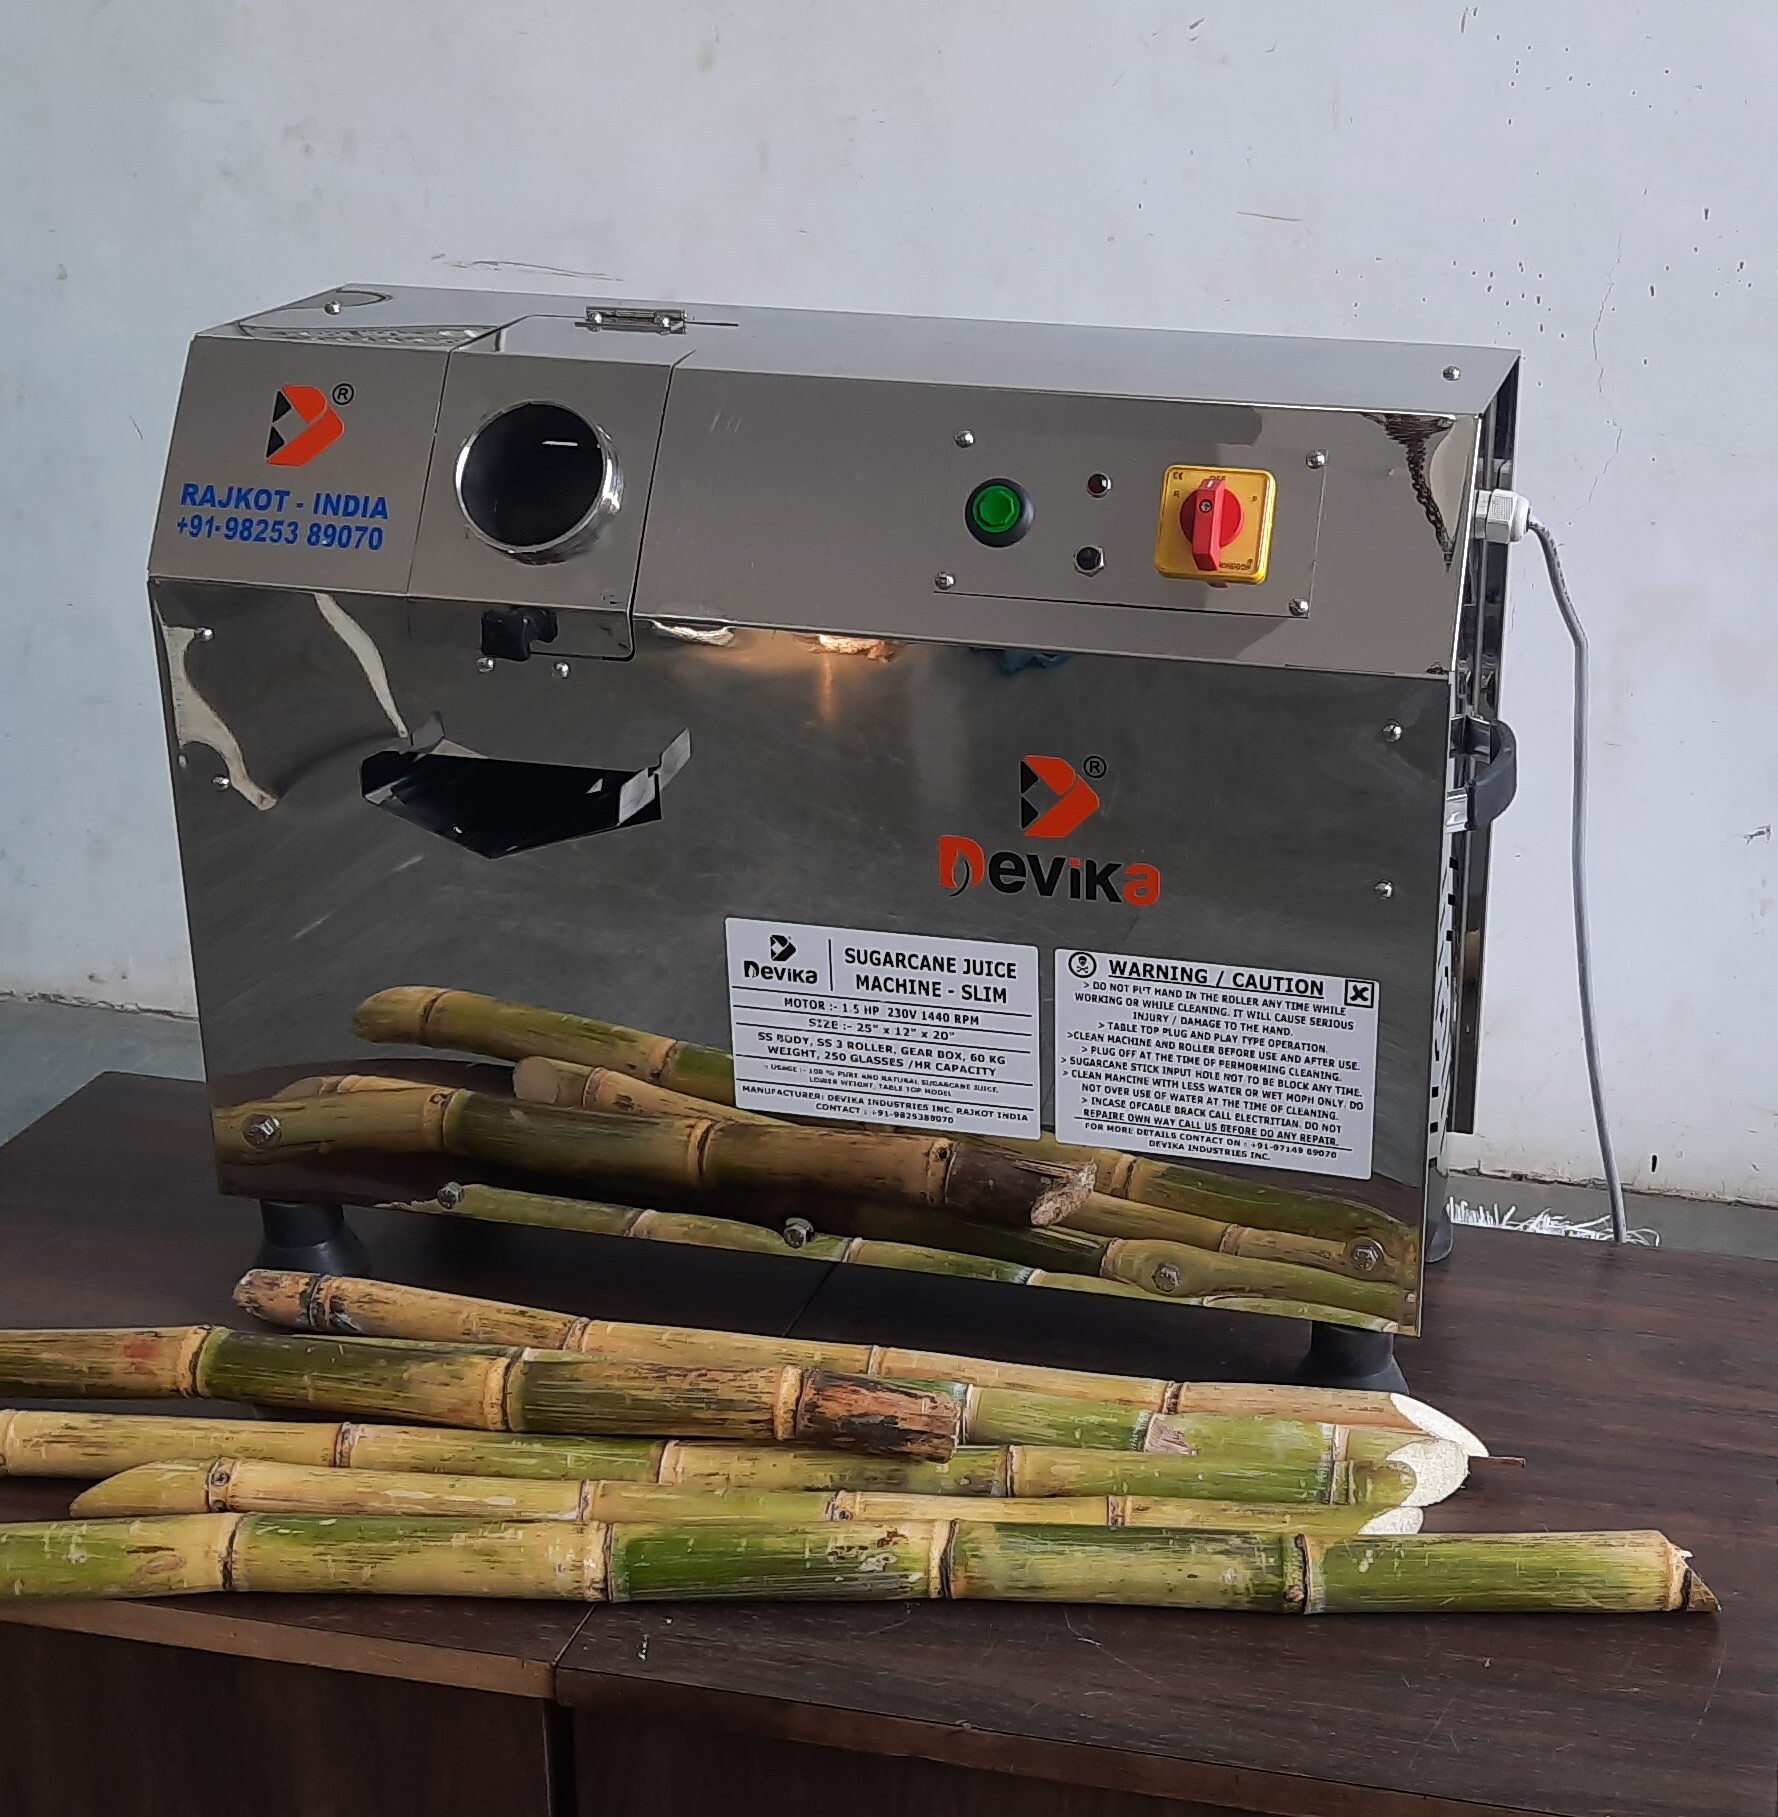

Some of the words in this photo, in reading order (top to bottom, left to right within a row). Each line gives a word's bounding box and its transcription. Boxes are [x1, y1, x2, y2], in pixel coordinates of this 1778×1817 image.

[180, 483, 290, 512] RAJKOT
[313, 492, 389, 520] INDIA
[177, 514, 299, 544] +91-98253
[307, 522, 383, 550] 89070
[844, 947, 956, 973] SUGARCANE
[962, 958, 1017, 979] JUICE
[1108, 959, 1208, 984] WARNING
[1232, 972, 1324, 996] CAUTION
[855, 973, 942, 998] MACHINE
[961, 984, 1007, 1004] SLIM
[1092, 980, 1107, 991] DO
[1109, 982, 1129, 993] NOT
[1154, 987, 1182, 998] HAND
[1185, 990, 1197, 1000] IN
[1199, 991, 1219, 1002] THE
[1221, 994, 1259, 1006] ROLLER
[1261, 998, 1282, 1009] ANY
[1284, 1000, 1309, 1012] TIME
[1312, 1003, 1346, 1016] WHILE
[784, 997, 825, 1011] MOTOR
[863, 1005, 879, 1016] HP
[887, 1007, 917, 1019] 230V
[921, 1010, 950, 1023] 1440
[954, 1013, 979, 1025] RPM
[808, 1017, 838, 1030] SIZE
[1074, 991, 1123, 1006] WORKING
[1125, 997, 1139, 1007] OR
[1142, 999, 1174, 1011] WHILE
[1233, 1008, 1244, 1018] IT
[1246, 1010, 1271, 1021] WILL
[1274, 1012, 1306, 1025] CAUSE
[1309, 1016, 1354, 1030] SERIOUS
[1132, 1011, 1169, 1023] INJURY
[1180, 1016, 1221, 1029] DAMAGE
[1223, 1020, 1237, 1031] TO
[1239, 1022, 1259, 1033] THE
[757, 1031, 773, 1041] SS
[816, 1037, 832, 1048] SS
[900, 1046, 933, 1057] GEAR
[989, 1054, 1005, 1065] KG
[1107, 1021, 1137, 1033] TABLE
[1140, 1024, 1159, 1035] TOP
[1162, 1027, 1187, 1038] PLUG
[1189, 1030, 1211, 1041] AND
[1213, 1032, 1238, 1043] PLAY
[1241, 1035, 1265, 1047] TYPE
[824, 1050, 846, 1062] 250
[849, 1053, 904, 1067] GLASSES
[935, 1062, 996, 1076] CAPACITY
[1090, 1045, 1116, 1057] PLUG
[1118, 1048, 1136, 1058] OFF
[1139, 1050, 1152, 1060] AT
[1155, 1052, 1173, 1063] THE
[1175, 1054, 1200, 1065] TIME
[1203, 1057, 1216, 1067] OF
[1107, 1034, 1151, 1047] MACHINE
[1154, 1039, 1176, 1050] AND
[1178, 1041, 1215, 1054] ROLLER
[1217, 1046, 1255, 1059] BEFORE
[1258, 1050, 1277, 1061] USE
[1279, 1053, 1301, 1064] AND
[1303, 1055, 1335, 1068] AFTER
[1069, 1056, 1128, 1070] SUGARCANE
[1130, 1062, 1159, 1074] STICK
[1161, 1065, 1191, 1077] INPUT
[1223, 1072, 1244, 1083] NOT
[1247, 1075, 1260, 1085] TO
[1262, 1077, 1274, 1087] BE
[1277, 1078, 1309, 1091] BLOCK
[1311, 1083, 1332, 1093] ANY
[1071, 1069, 1102, 1080] CLEAN
[1152, 1077, 1179, 1089] WITH
[1181, 1081, 1205, 1092] LESS
[1207, 1083, 1242, 1096] WATER
[1244, 1088, 1259, 1097] OR
[1261, 1089, 1283, 1100] WET
[1285, 1092, 1314, 1104] MOPH
[1349, 1100, 1364, 1111] DO
[1081, 1082, 1102, 1093] NOT
[1104, 1085, 1129, 1096] OVER
[1132, 1088, 1151, 1098] USE
[1153, 1090, 1167, 1100] OF
[1169, 1092, 1203, 1104] WATER
[1205, 1096, 1219, 1106] AT
[1221, 1098, 1240, 1109] THE
[1242, 1100, 1267, 1112] TIME
[1270, 1103, 1283, 1113] OF
[997, 1111, 1028, 1121] INDIA
[1127, 1113, 1150, 1124] OWN
[1153, 1116, 1175, 1126] WAY
[1178, 1118, 1201, 1130] CALL
[1204, 1121, 1217, 1132] US
[1260, 1128, 1274, 1138] DO
[1276, 1130, 1297, 1140] ANY
[1208, 1109, 1231, 1121] CALL
[1304, 1120, 1319, 1131] DO
[1321, 1123, 1342, 1134] NOT
[1084, 1122, 1103, 1131] FOR
[1106, 1124, 1133, 1134] MORE
[1179, 1133, 1223, 1144] CONTACT
[1226, 1138, 1241, 1147] ON
